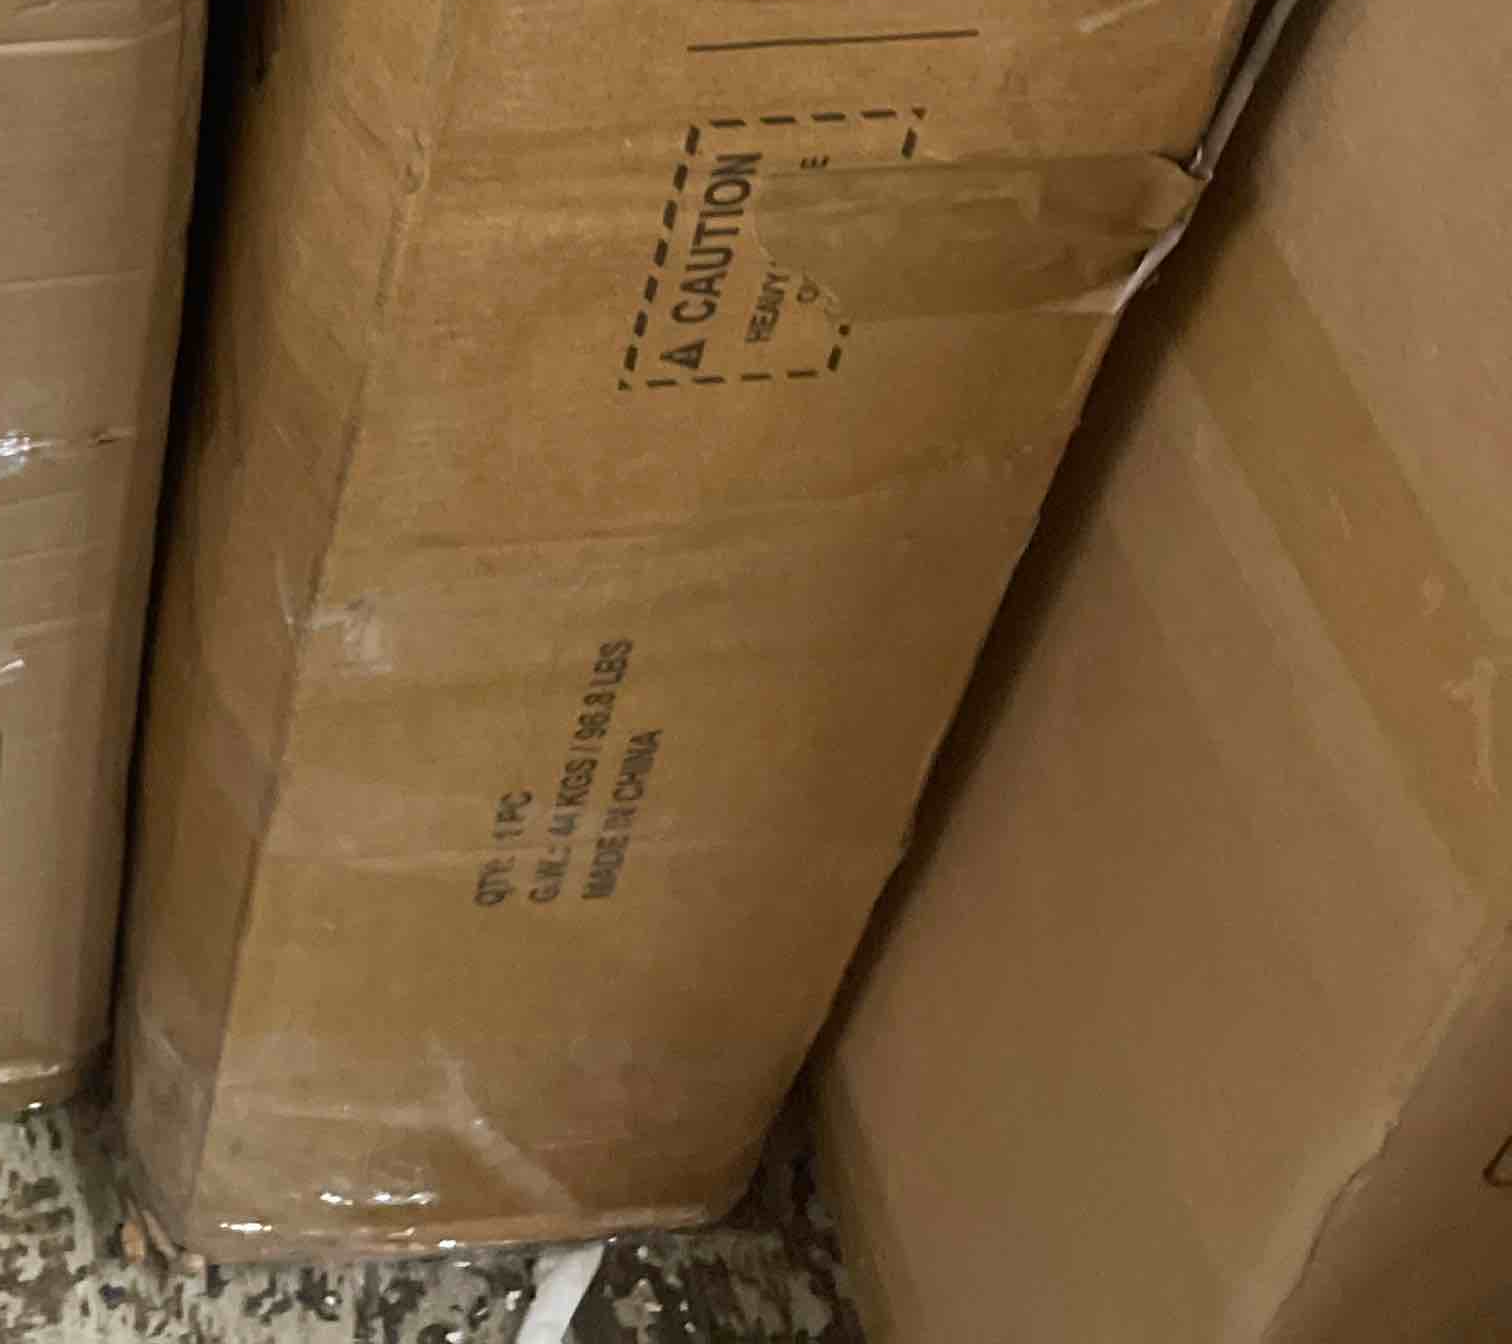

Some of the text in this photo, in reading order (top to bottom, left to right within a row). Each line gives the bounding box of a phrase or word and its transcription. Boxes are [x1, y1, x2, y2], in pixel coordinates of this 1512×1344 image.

[670, 152, 764, 326] CAUTION
[745, 272, 790, 344] HEAVY
[611, 729, 662, 803] CHINA
